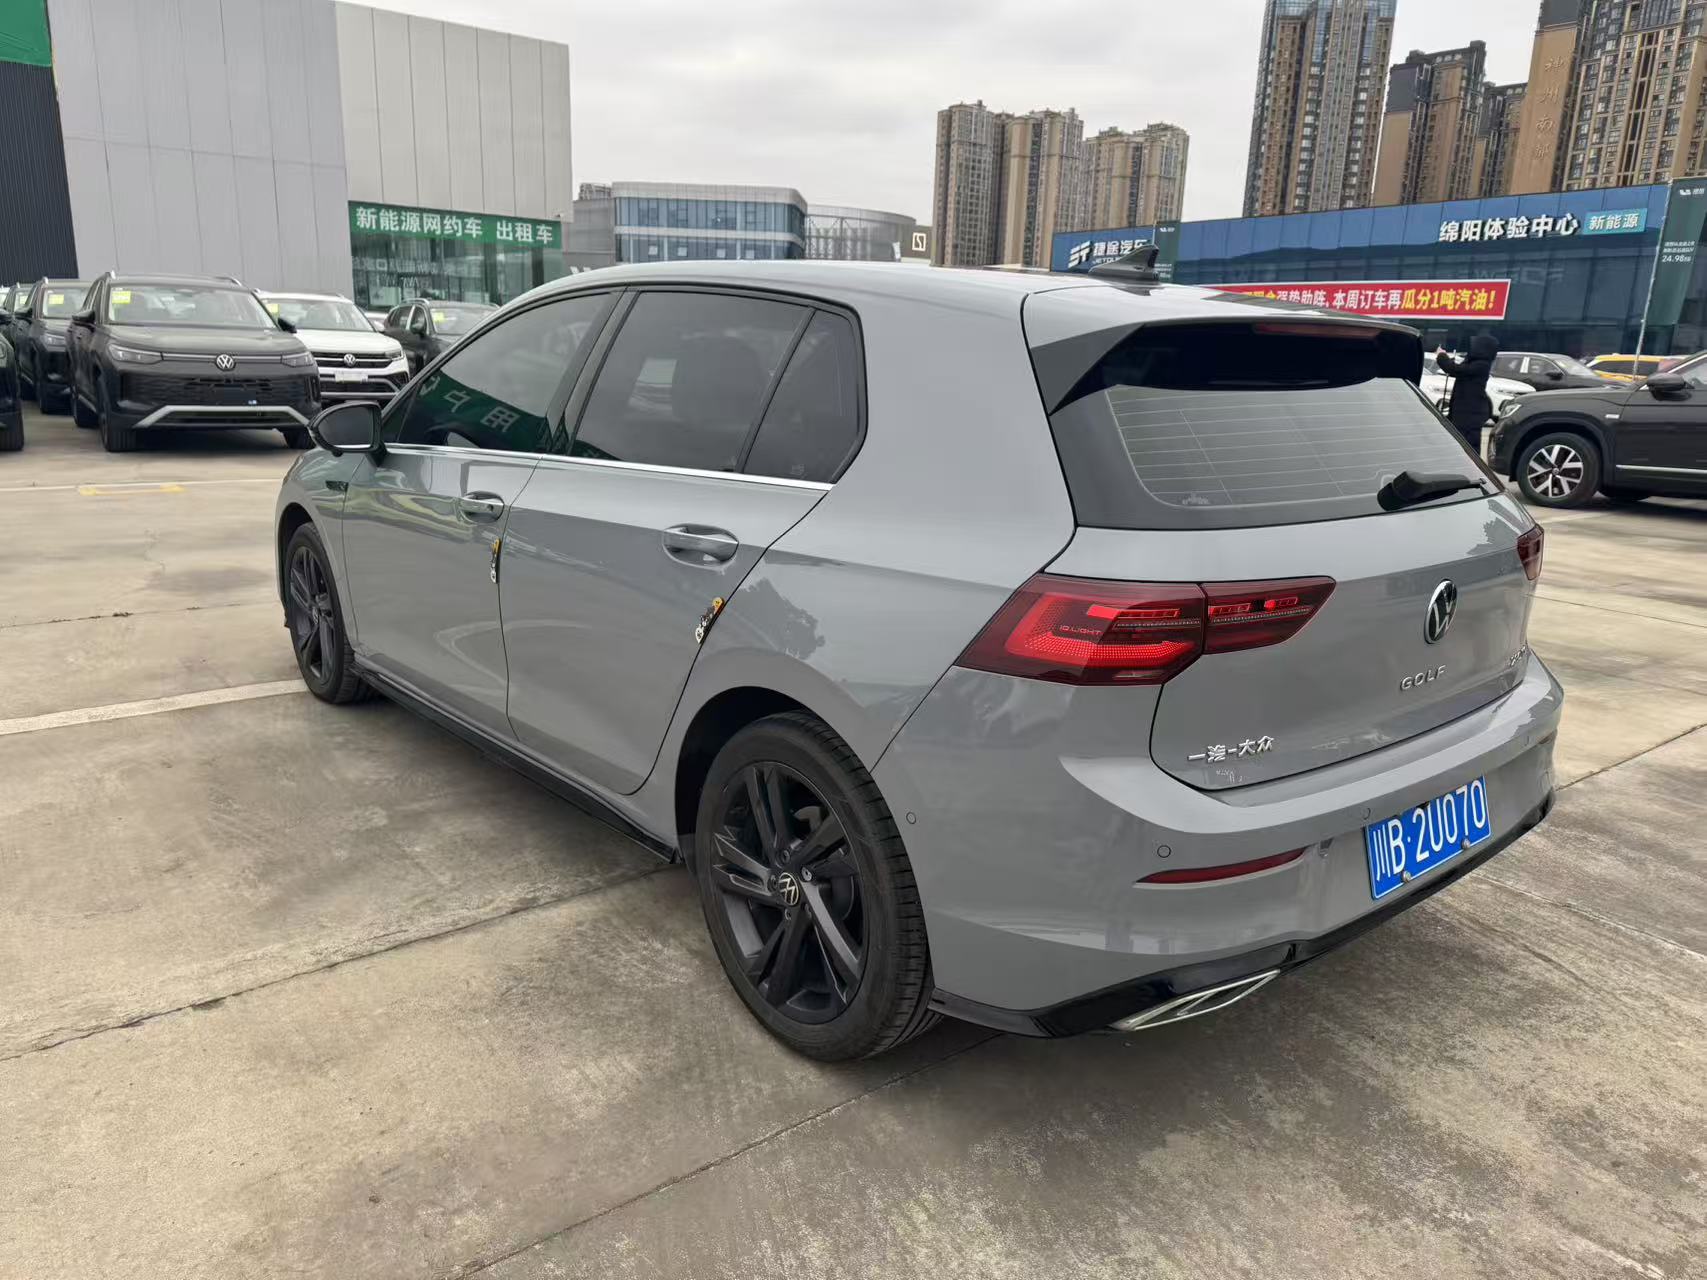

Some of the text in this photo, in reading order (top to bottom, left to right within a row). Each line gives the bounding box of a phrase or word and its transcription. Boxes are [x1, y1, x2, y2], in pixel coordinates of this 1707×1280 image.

[356, 205, 553, 244] 新能源网约车 出租车
[1439, 212, 1578, 242] 绵阳体验中心
[1588, 213, 1639, 231] 新能源
[1400, 664, 1446, 691] GOLF
